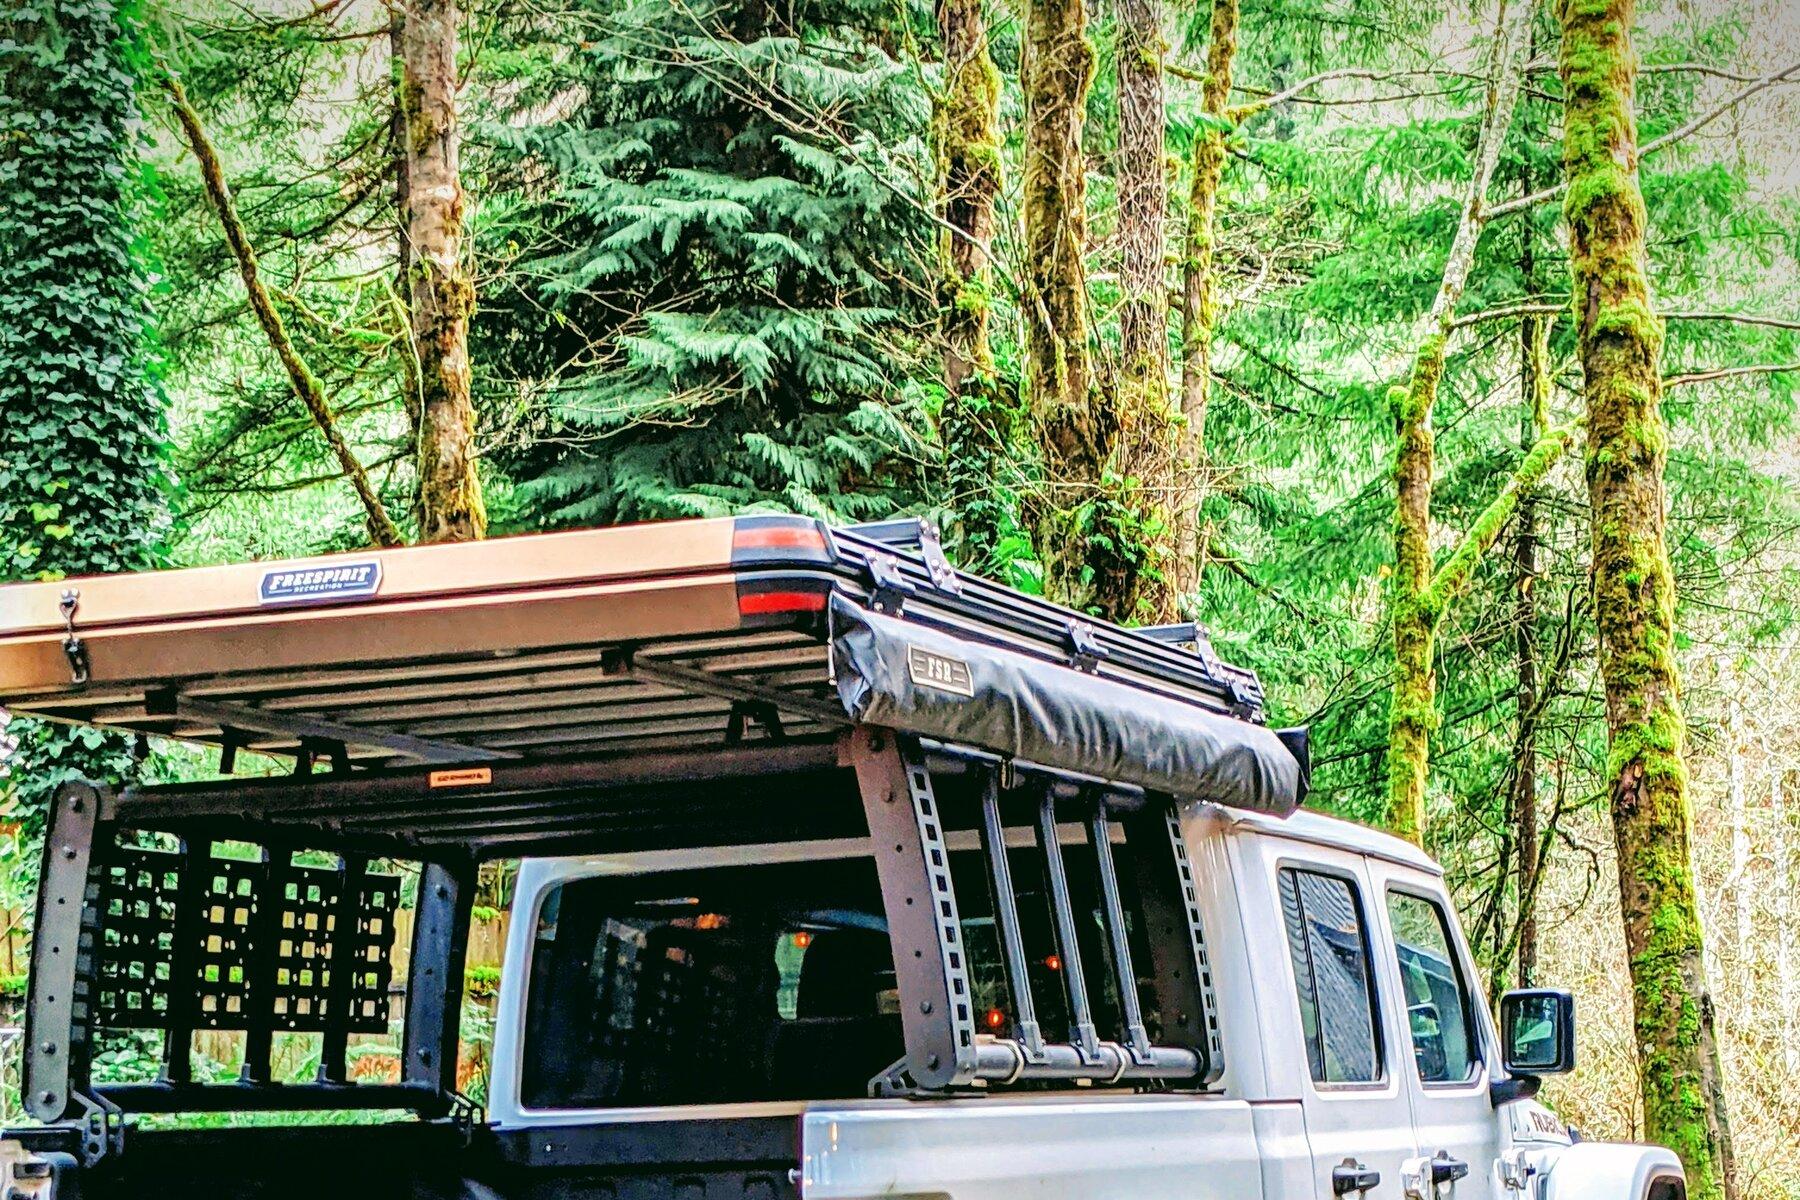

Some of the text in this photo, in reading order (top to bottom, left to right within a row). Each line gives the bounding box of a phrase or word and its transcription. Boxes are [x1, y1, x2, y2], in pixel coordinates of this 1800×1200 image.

[269, 567, 371, 590] FREESPIRIT
[293, 583, 343, 593] RECREATION
[928, 657, 952, 682] FSR
